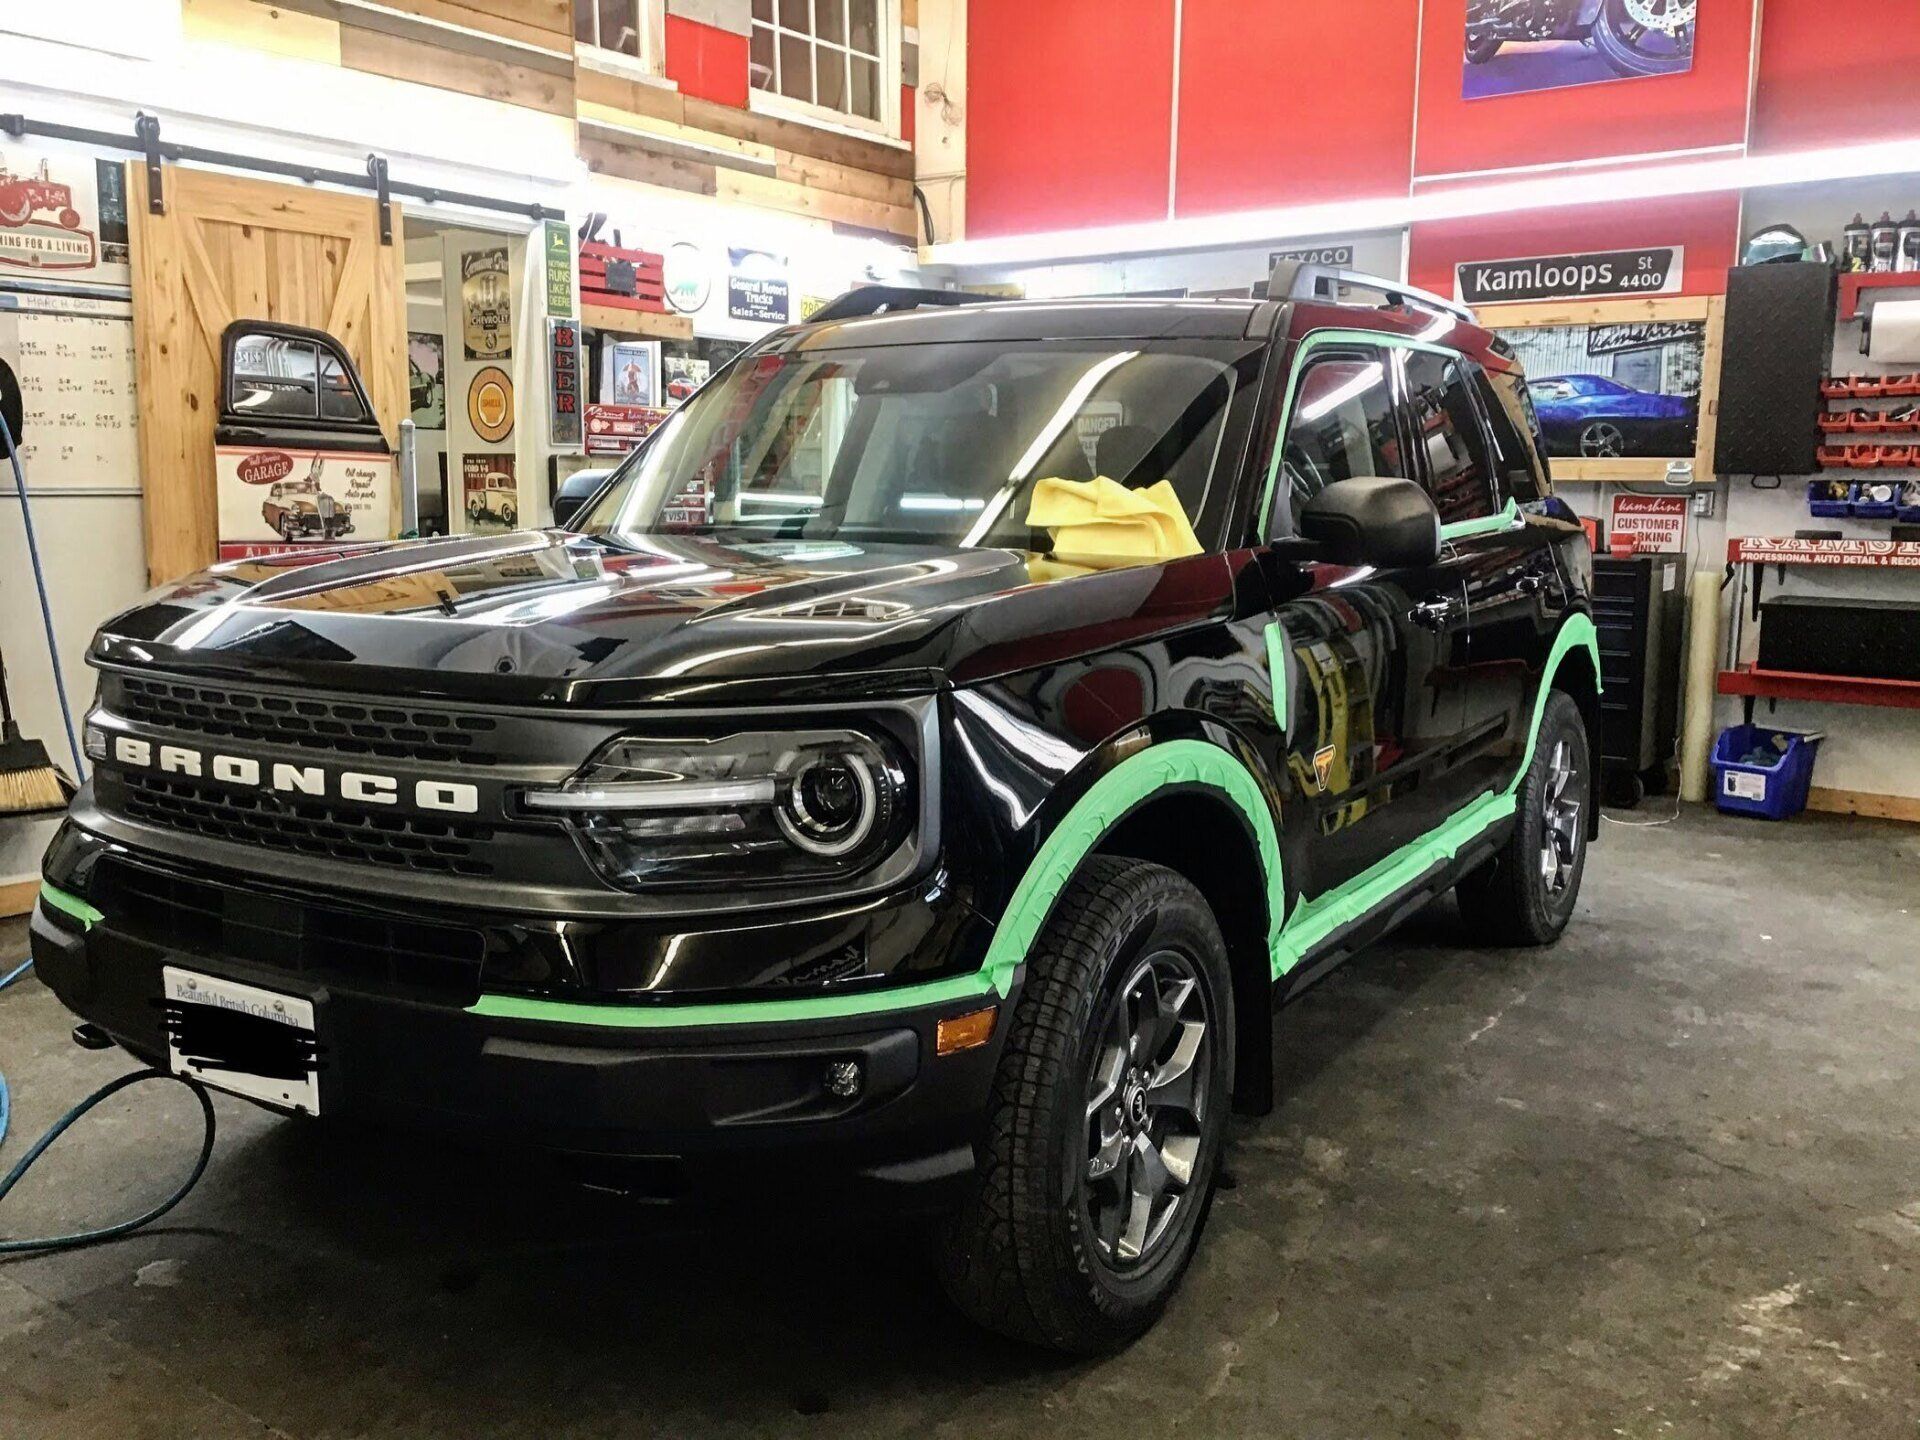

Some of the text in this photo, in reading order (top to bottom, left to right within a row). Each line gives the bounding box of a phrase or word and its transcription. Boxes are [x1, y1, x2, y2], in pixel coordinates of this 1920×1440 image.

[25, 237, 43, 249] FOR
[47, 240, 53, 250] A
[56, 242, 89, 254] LIVING
[1638, 256, 1653, 271] St
[548, 269, 570, 282] RUNS
[1476, 263, 1613, 292] Kamloops
[1619, 272, 1662, 288] 4400
[549, 282, 564, 294] LIKE
[549, 295, 570, 307] DEERE
[745, 291, 774, 305] Trucks
[554, 326, 576, 414] BEER
[1077, 416, 1117, 434] DANGER
[244, 461, 289, 483] GARAGE
[1619, 498, 1681, 512] kamshine
[669, 511, 687, 521] VISA
[1617, 517, 1680, 530] CUSTOMER
[1636, 531, 1672, 543] RKING
[1740, 552, 1920, 566] PROFESSIONAL AUTO DETAIL & RECO
[115, 736, 479, 814] BRONCO
[176, 984, 299, 1026] Beautiful British Columbia
